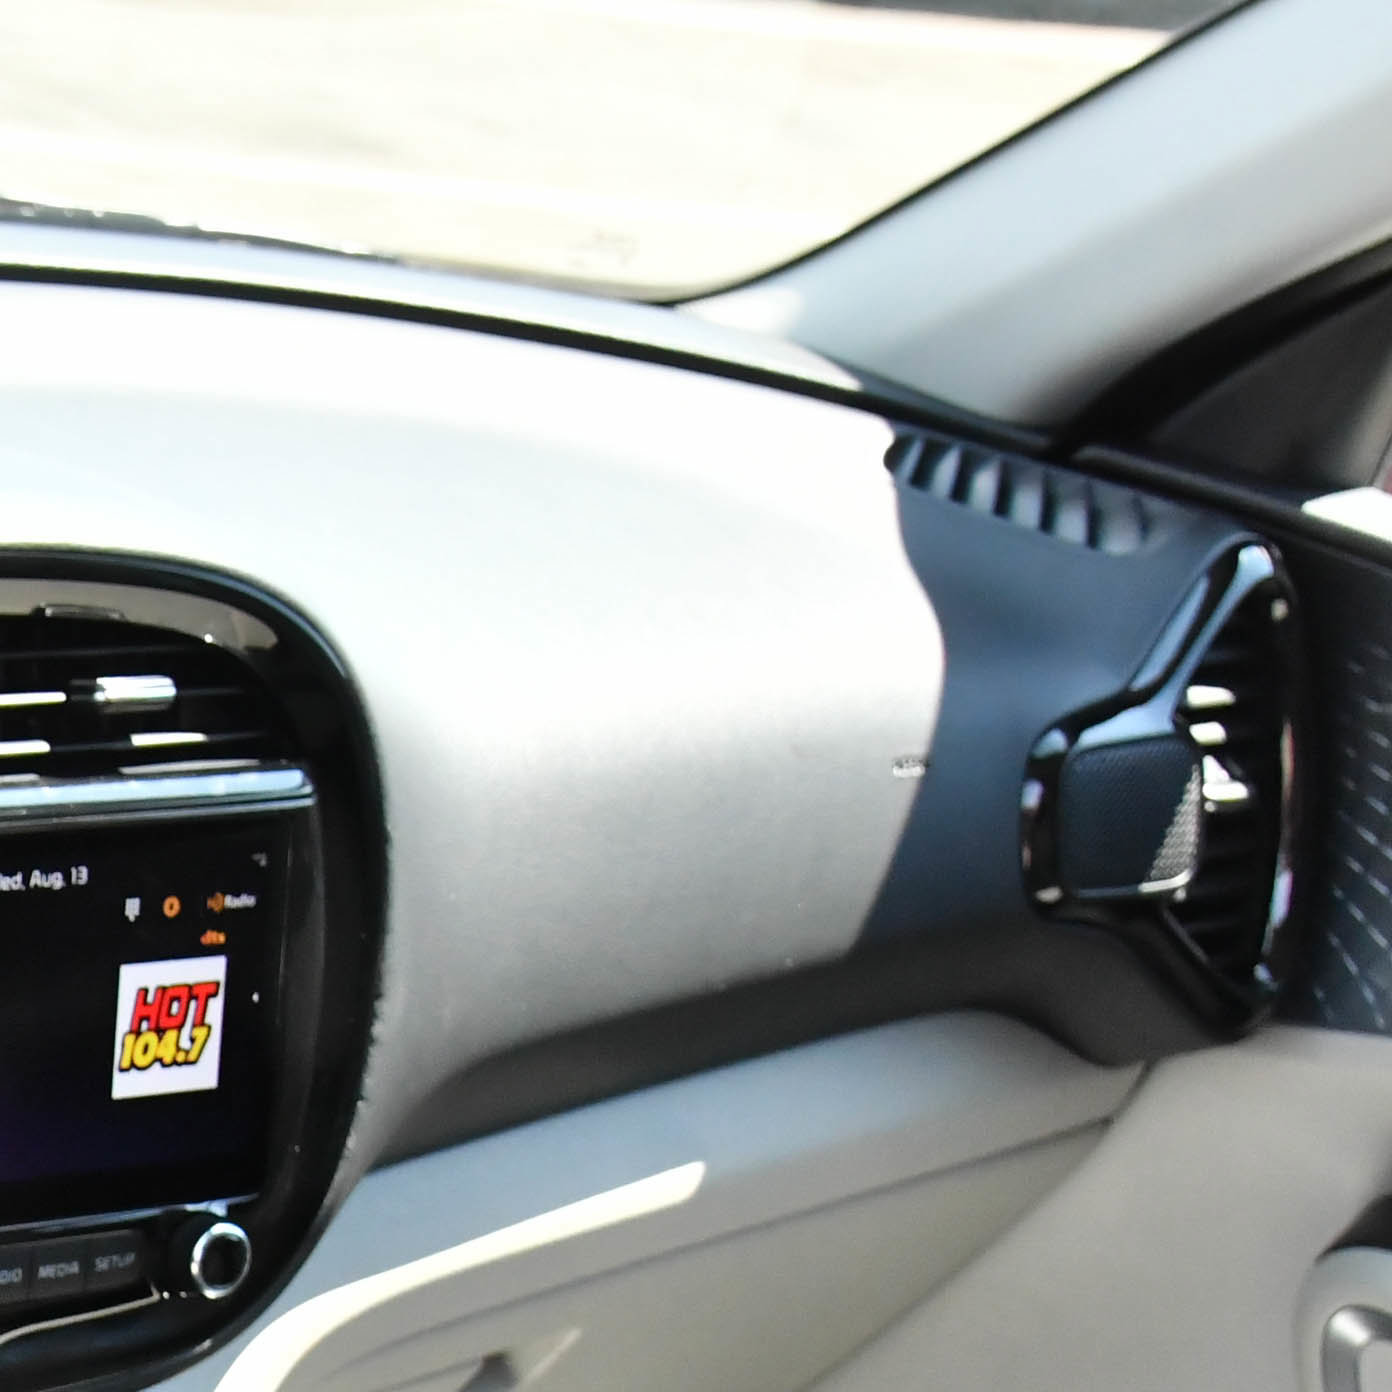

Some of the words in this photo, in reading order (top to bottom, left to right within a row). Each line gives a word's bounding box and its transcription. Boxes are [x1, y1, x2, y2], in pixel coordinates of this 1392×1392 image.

[71, 865, 88, 885] 13
[130, 981, 220, 1033] HOT
[119, 1024, 211, 1072] 104.7
